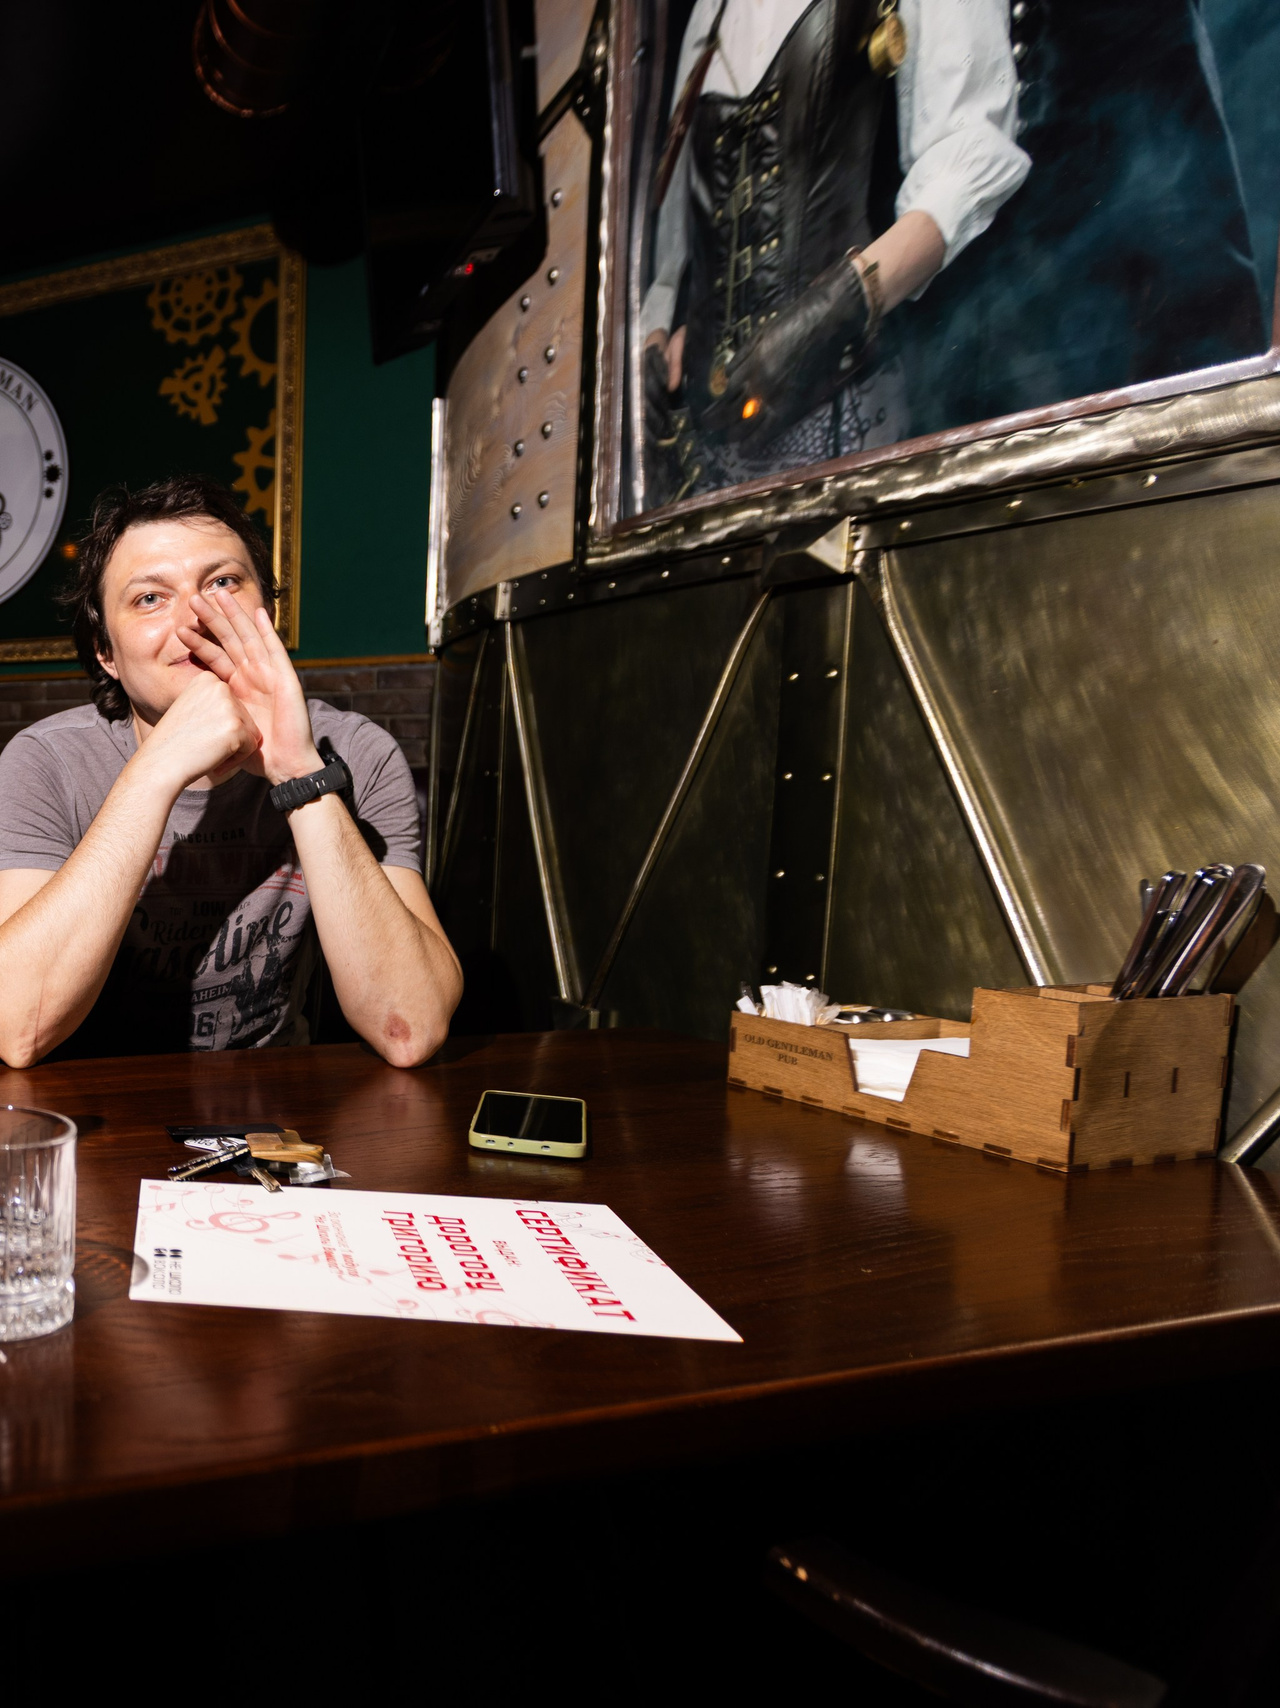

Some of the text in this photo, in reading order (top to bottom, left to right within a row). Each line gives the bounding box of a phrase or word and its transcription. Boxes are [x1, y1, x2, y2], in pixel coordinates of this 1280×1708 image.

[222, 827, 246, 840] CAR
[193, 901, 226, 917] LOW
[120, 900, 294, 984] asoline
[150, 919, 213, 945] Rider
[744, 1033, 835, 1062] OLD GENTLEMAN
[777, 1053, 798, 1066] PUB
[515, 1208, 637, 1321] СЕРТИФИКАТ
